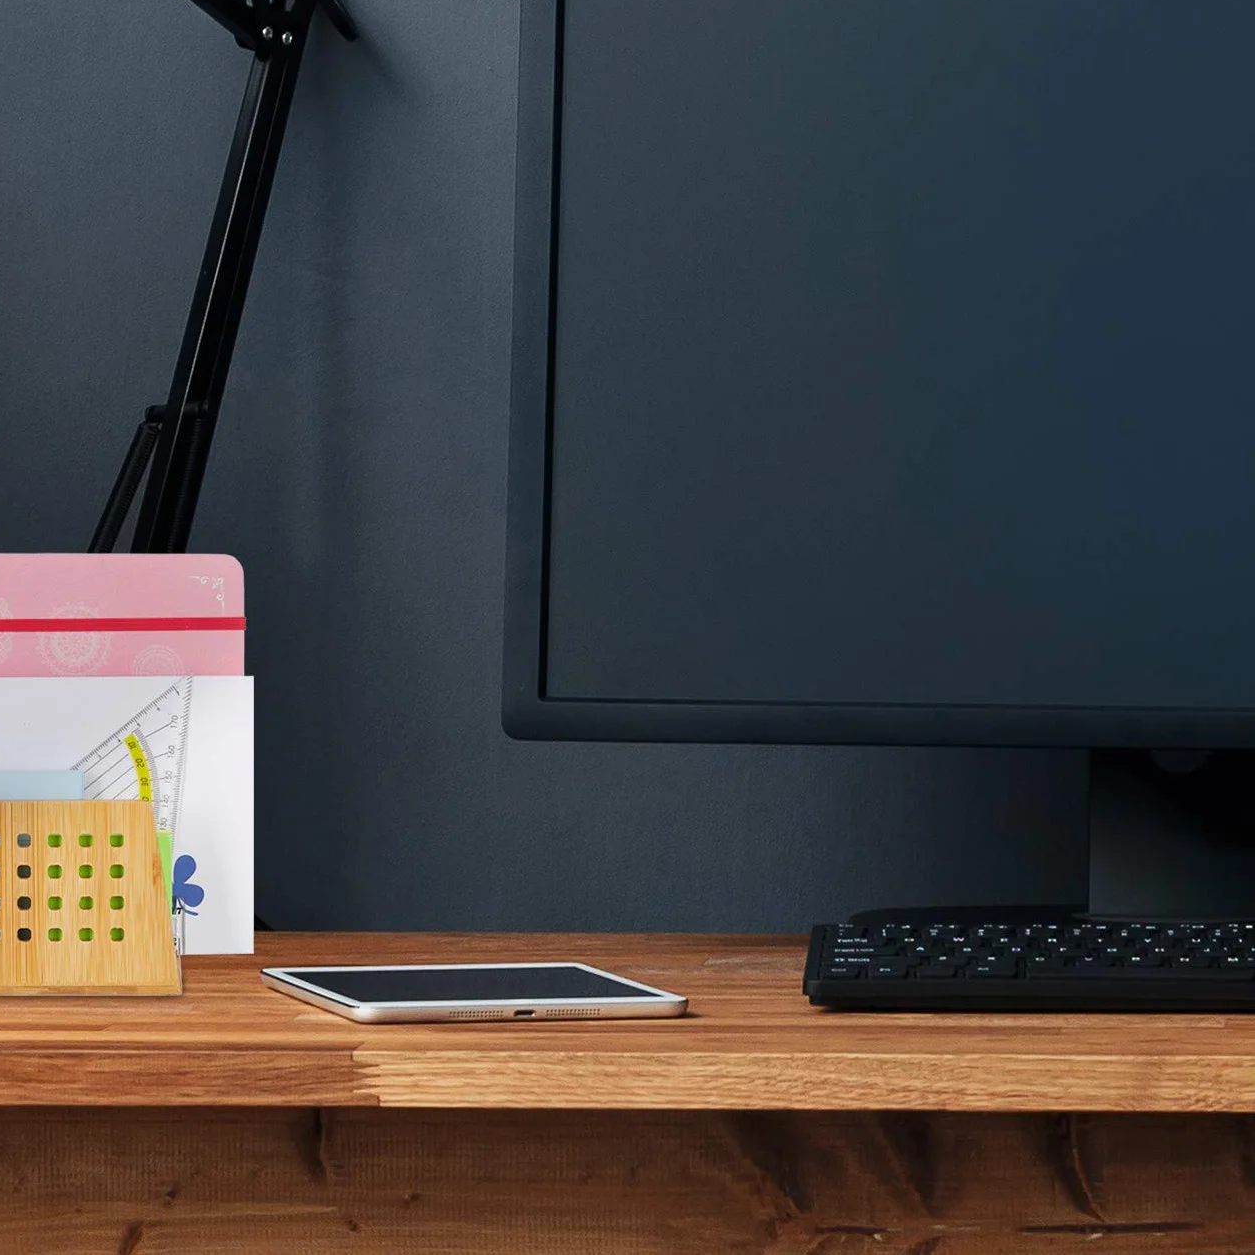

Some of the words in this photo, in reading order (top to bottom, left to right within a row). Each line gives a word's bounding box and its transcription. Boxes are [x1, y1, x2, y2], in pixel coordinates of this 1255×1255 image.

[170, 714, 179, 729] 170
[167, 745, 176, 758] 160
[135, 758, 145, 768] 20
